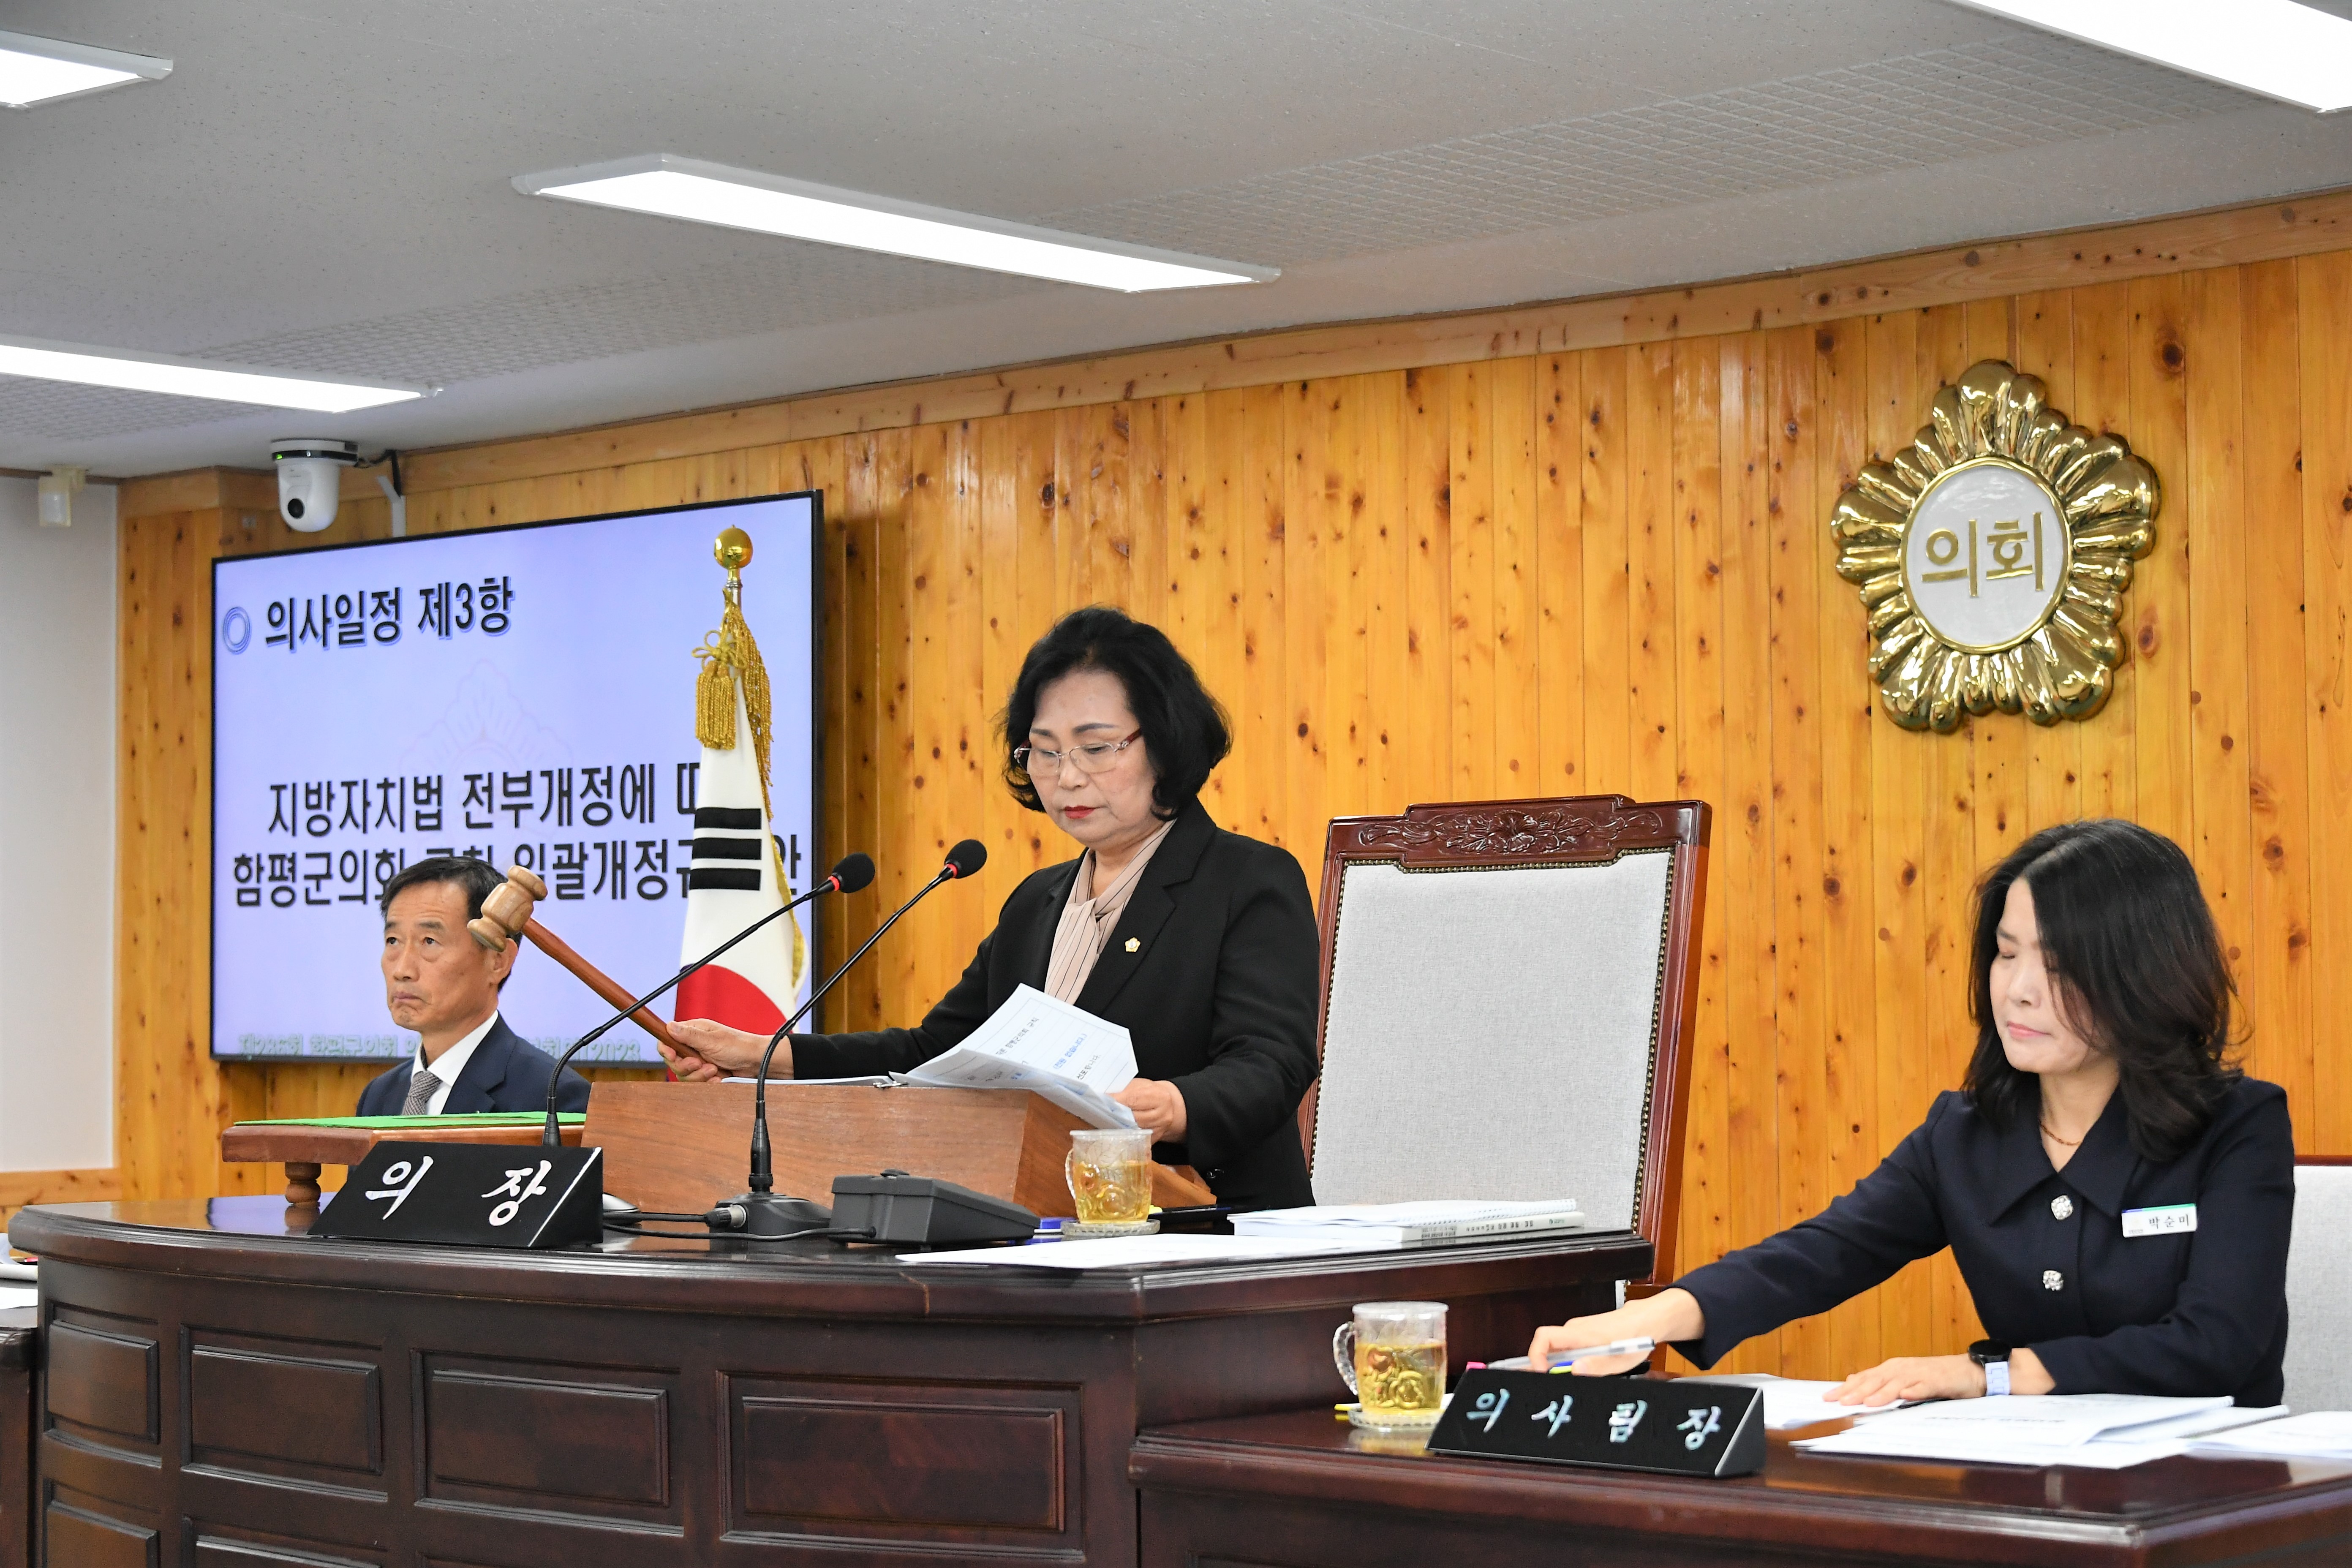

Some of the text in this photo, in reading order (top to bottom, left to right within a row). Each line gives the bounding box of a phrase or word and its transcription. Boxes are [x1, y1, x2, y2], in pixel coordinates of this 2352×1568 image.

[1922, 512, 2044, 598] 의회
[265, 576, 515, 651] 의사일정 제3항
[268, 775, 443, 836] 지방자치법
[463, 763, 655, 829] 전부개정에
